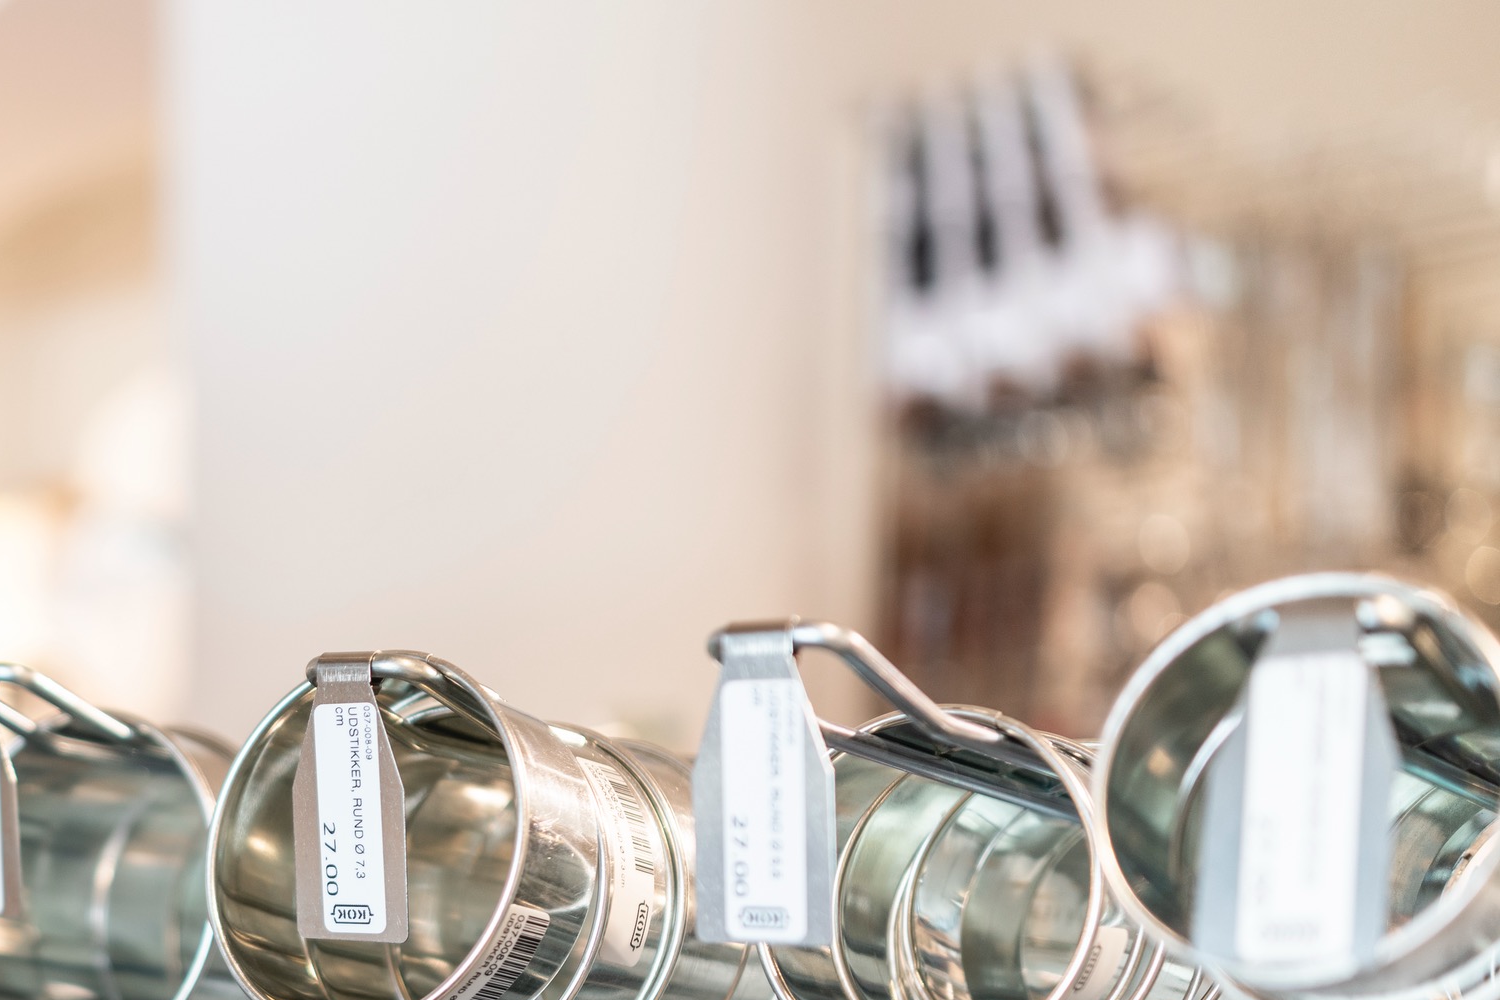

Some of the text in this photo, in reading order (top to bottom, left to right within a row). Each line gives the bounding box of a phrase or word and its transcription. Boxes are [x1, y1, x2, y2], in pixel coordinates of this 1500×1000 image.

[334, 706, 346, 727] cm
[363, 706, 374, 761] 037-008-09
[347, 706, 362, 793] UDSTIKKER,
[352, 798, 364, 839] RUND
[323, 822, 339, 896] 27.00
[355, 860, 366, 879] 7,3
[484, 914, 526, 977] 037-008-09
[458, 971, 482, 997] RUND
